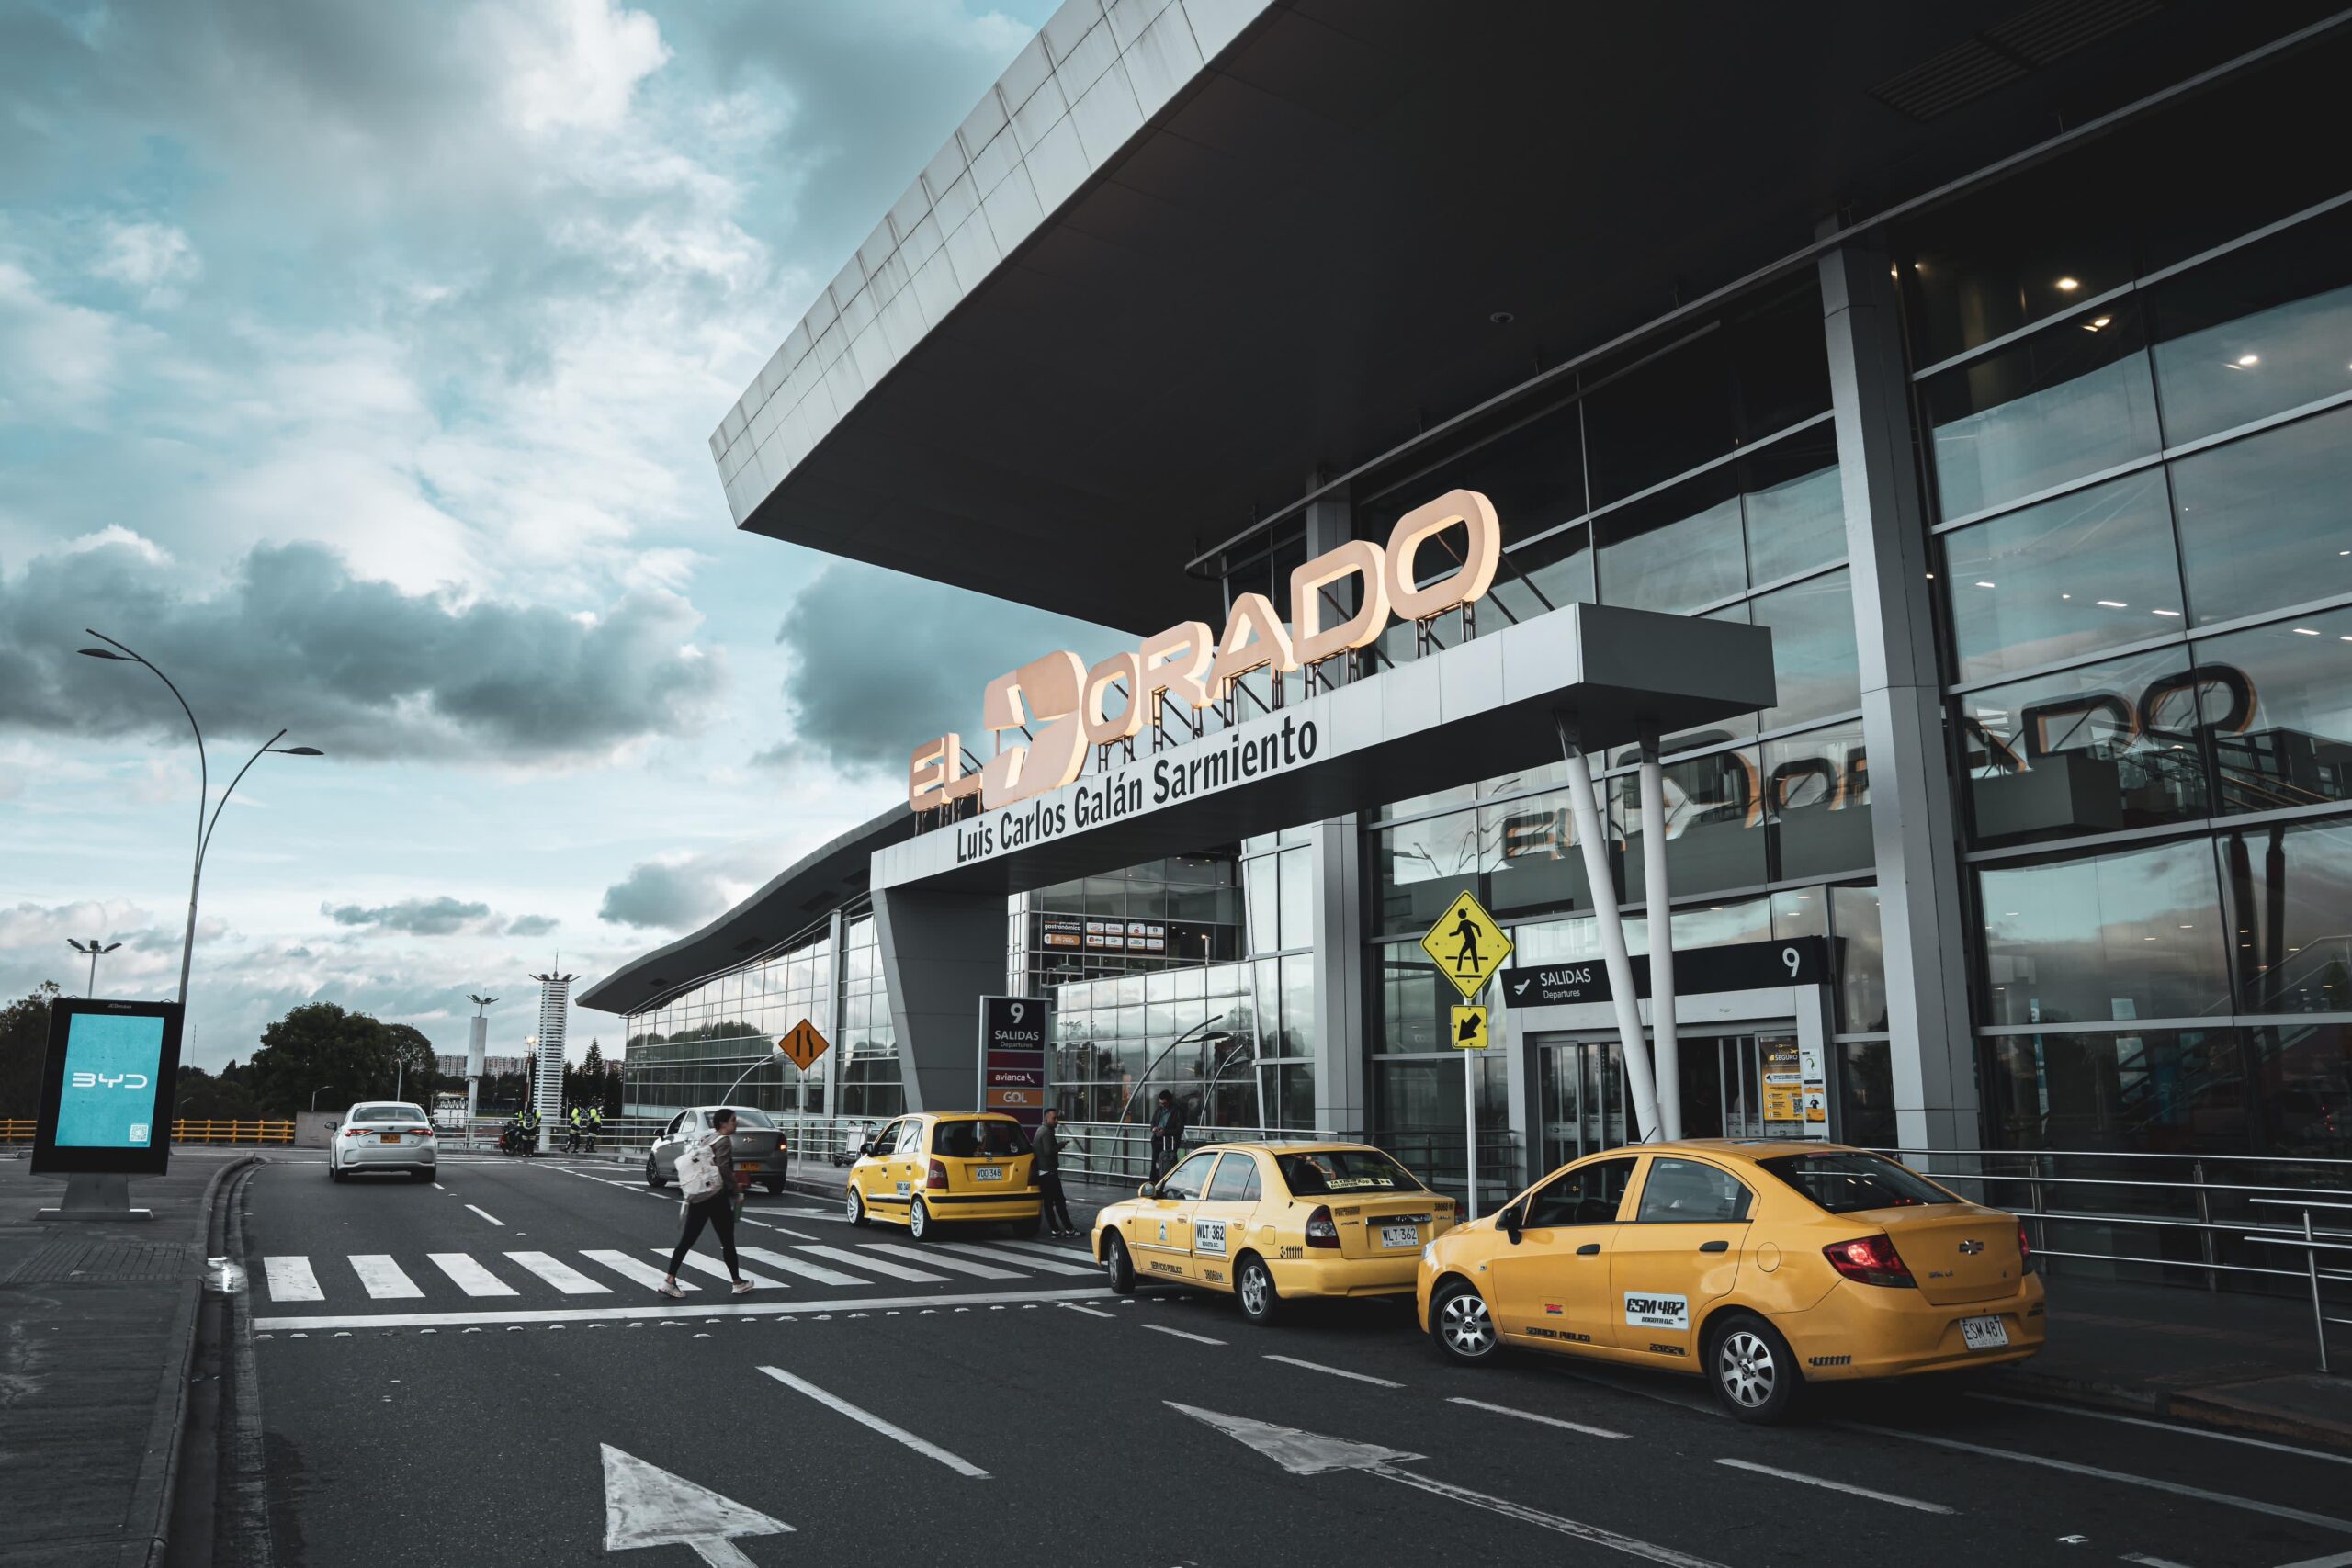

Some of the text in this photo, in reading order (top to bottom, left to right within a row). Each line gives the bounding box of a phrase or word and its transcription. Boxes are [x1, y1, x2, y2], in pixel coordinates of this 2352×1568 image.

[908, 488, 1501, 812] EL DORADO
[957, 716, 1317, 863] Luis Carlos Galán Sarmiento
[1782, 947, 1801, 977] 9
[1539, 967, 1591, 987] SALIDAS
[1543, 988, 1580, 1001] Departures
[1010, 1002, 1024, 1024] 9
[995, 1030, 1039, 1041] SALIDAS
[72, 1072, 148, 1089] BYD
[995, 1073, 1026, 1082] avianca
[1002, 1091, 1027, 1103] GOL
[1196, 1224, 1224, 1241] WLT 362
[1383, 1228, 1417, 1241] WLT 362
[1150, 1261, 1167, 1271] SERVICIO
[1626, 1298, 1685, 1315] ESM 487
[1526, 1326, 1557, 1337] SERVICIO
[1962, 1320, 2004, 1340] ESM 487
